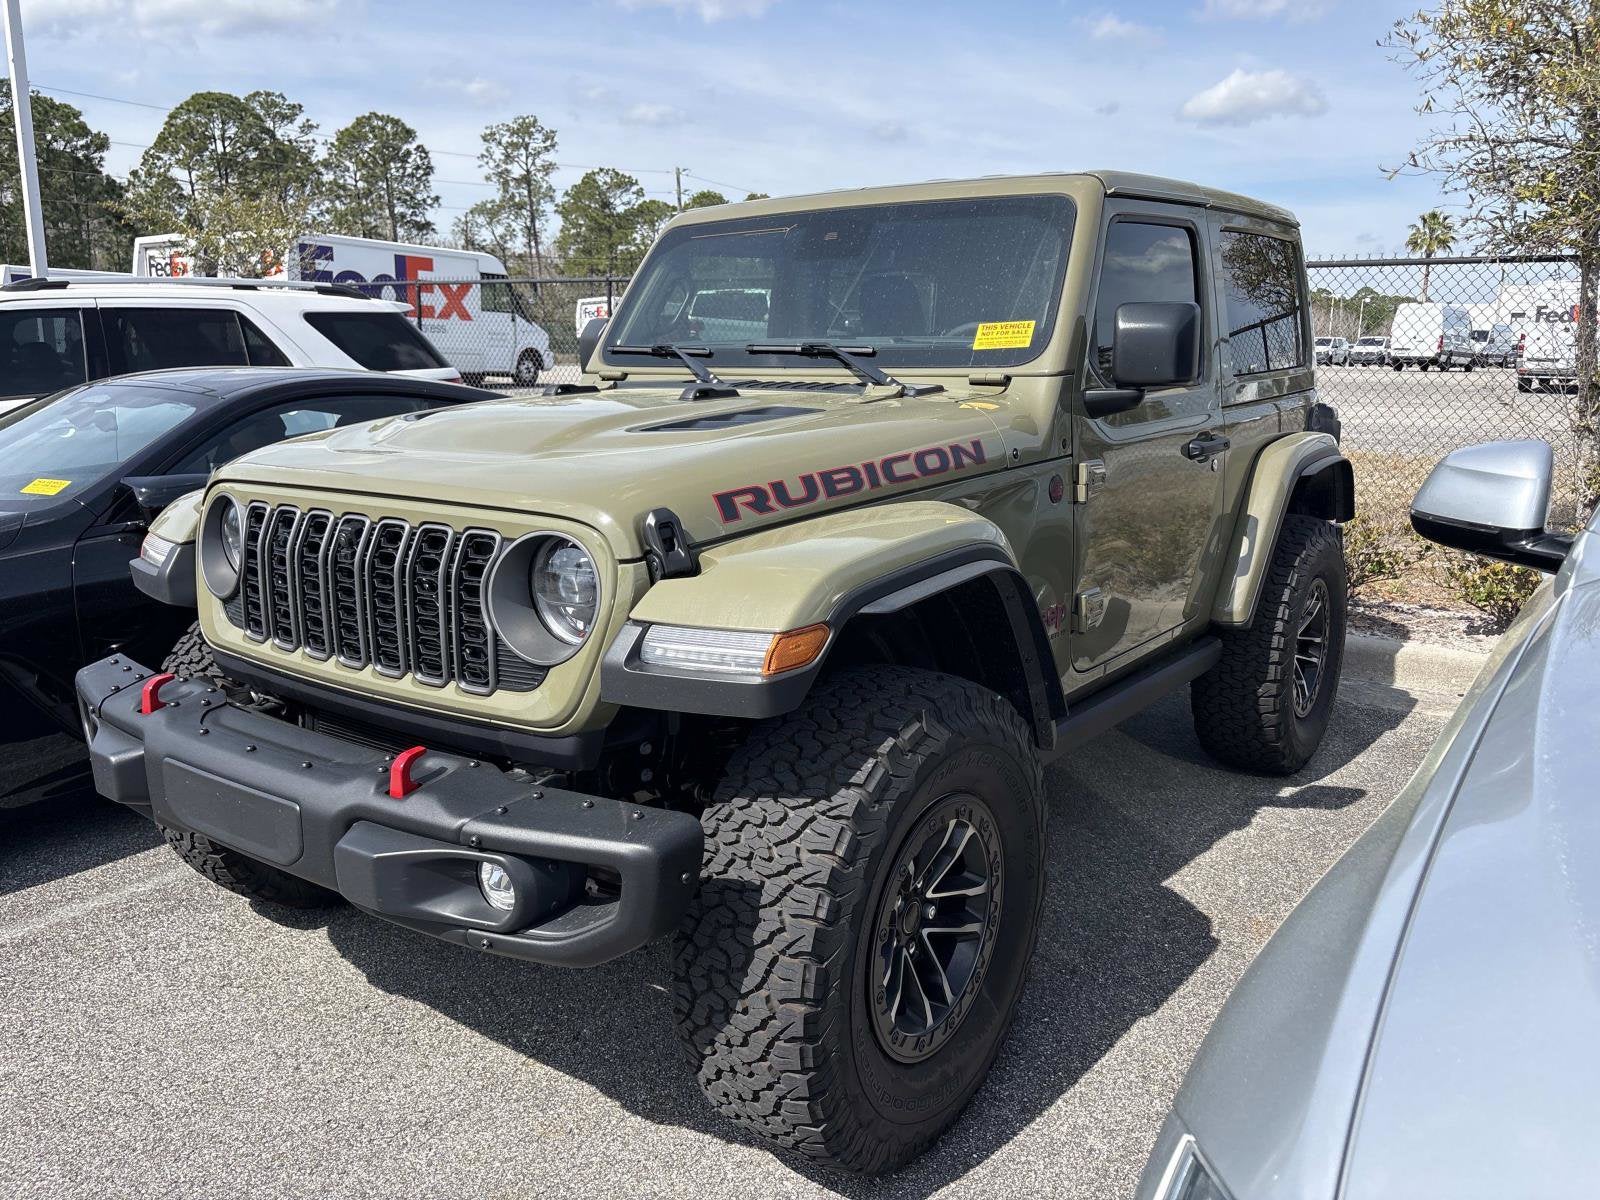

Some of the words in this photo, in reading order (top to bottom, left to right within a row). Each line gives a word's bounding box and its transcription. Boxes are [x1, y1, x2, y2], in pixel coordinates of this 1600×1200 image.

[1535, 304, 1580, 323] Fed
[1000, 322, 1032, 330] VEHICLE
[712, 438, 988, 524] RUBICON
